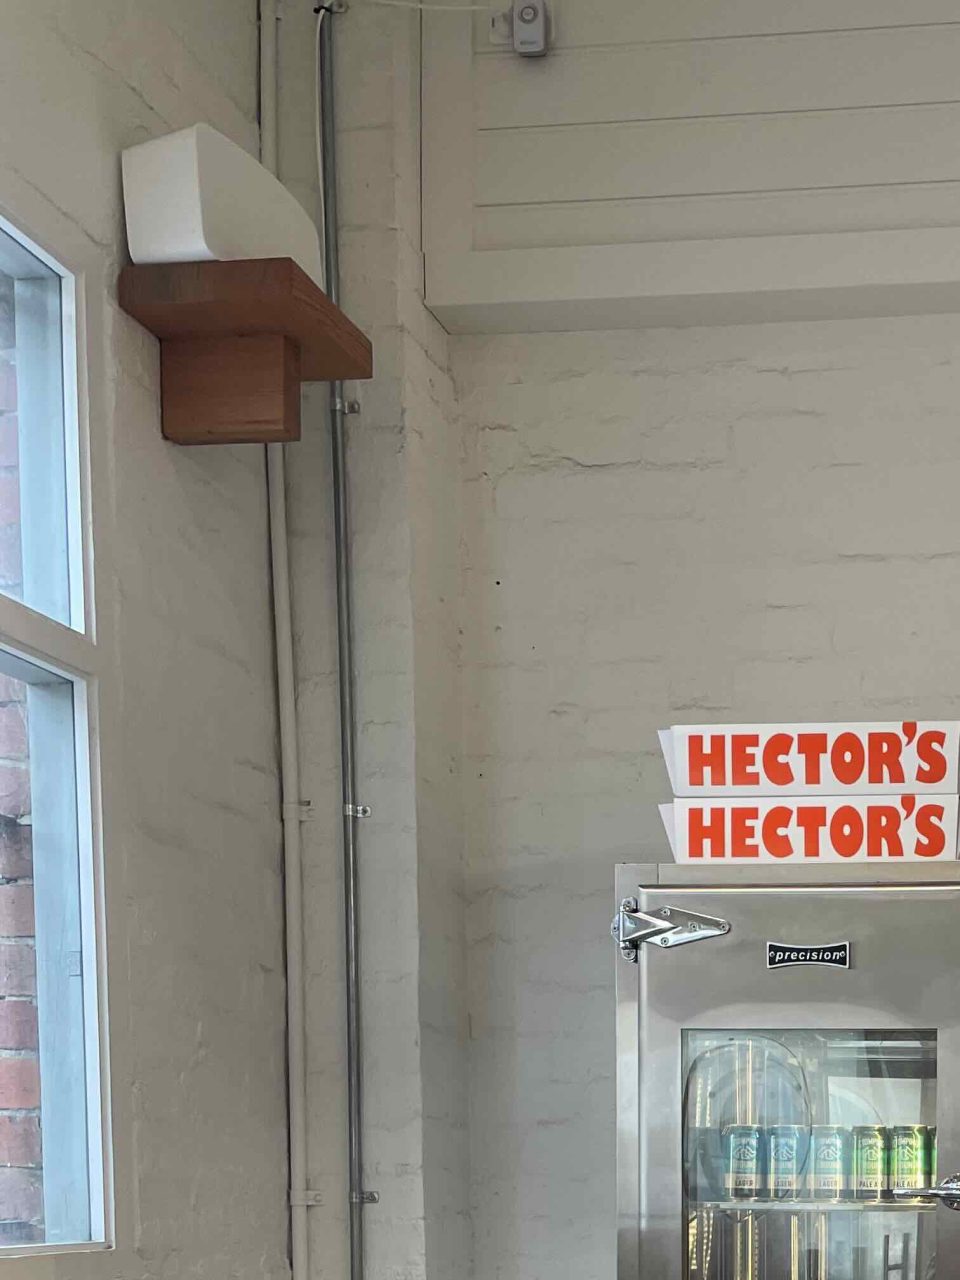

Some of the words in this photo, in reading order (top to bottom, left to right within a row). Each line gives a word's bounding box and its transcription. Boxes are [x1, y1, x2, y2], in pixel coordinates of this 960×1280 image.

[688, 721, 947, 786] HECTOR'S
[688, 794, 946, 858] HECTOR'S
[775, 950, 841, 962] precision
